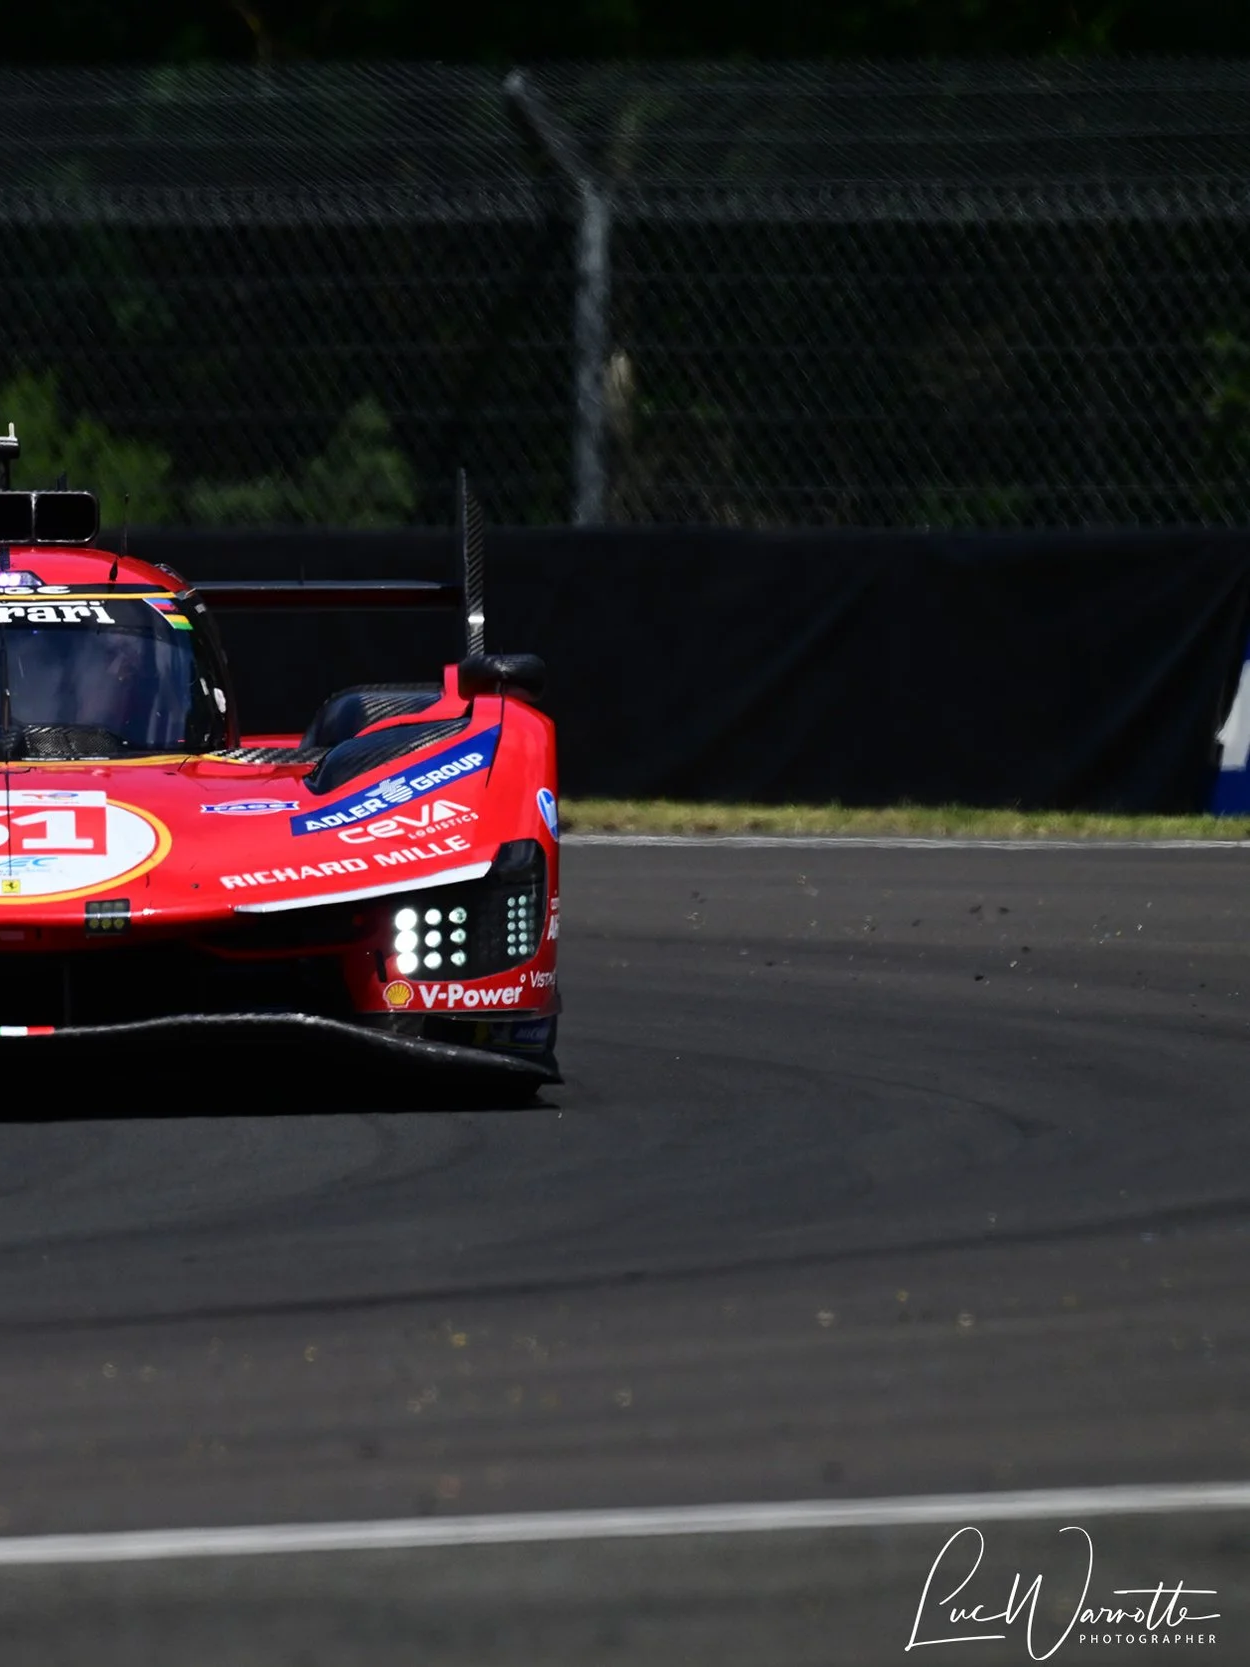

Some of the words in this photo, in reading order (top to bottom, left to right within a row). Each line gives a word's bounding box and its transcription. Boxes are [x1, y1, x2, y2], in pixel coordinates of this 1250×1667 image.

[305, 800, 392, 832] ADLER
[408, 752, 485, 792] GROUP
[407, 812, 479, 840] LOGISTICS
[219, 858, 369, 890] RICHARD
[376, 834, 472, 867] MILLE
[419, 983, 523, 1008] V-Power
